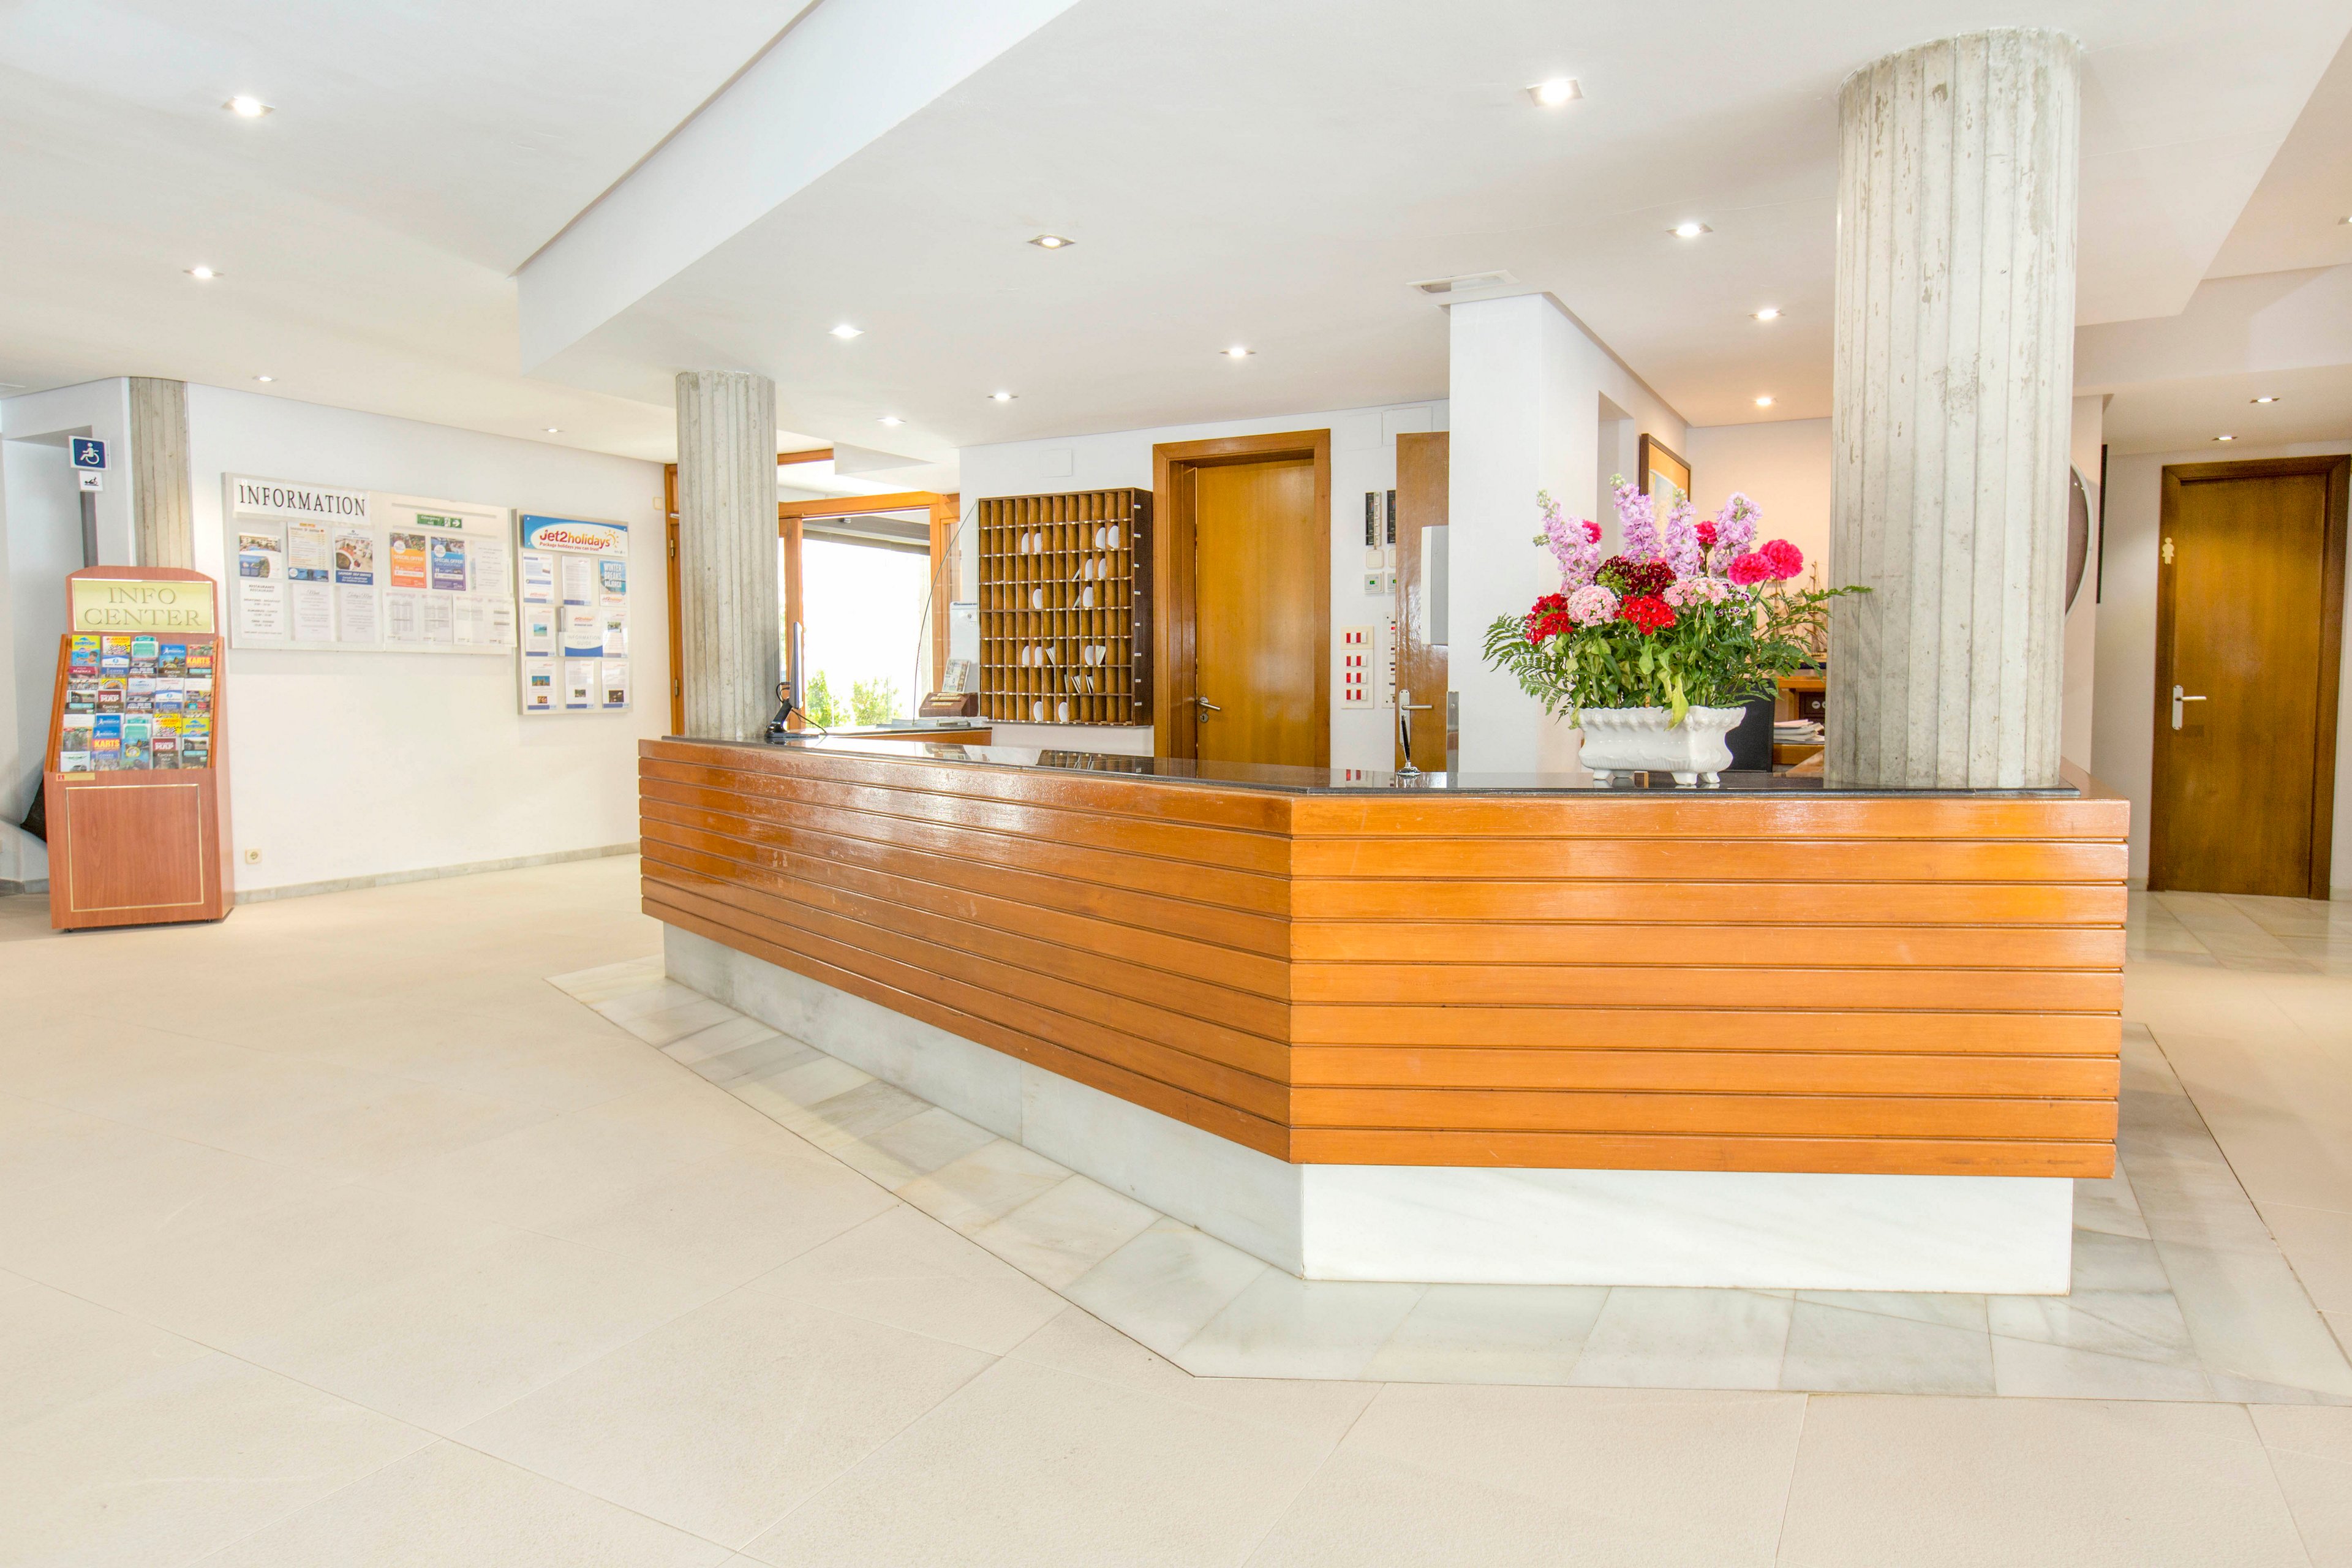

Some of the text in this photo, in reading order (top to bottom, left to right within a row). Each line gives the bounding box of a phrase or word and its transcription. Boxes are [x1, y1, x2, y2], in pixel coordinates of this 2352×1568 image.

[239, 484, 365, 516] INFORMATION
[603, 563, 622, 572] WINTER
[604, 571, 622, 580] BREAKS
[108, 587, 176, 604] INFO
[85, 608, 202, 626] CENTER
[94, 739, 120, 748] KARTS
